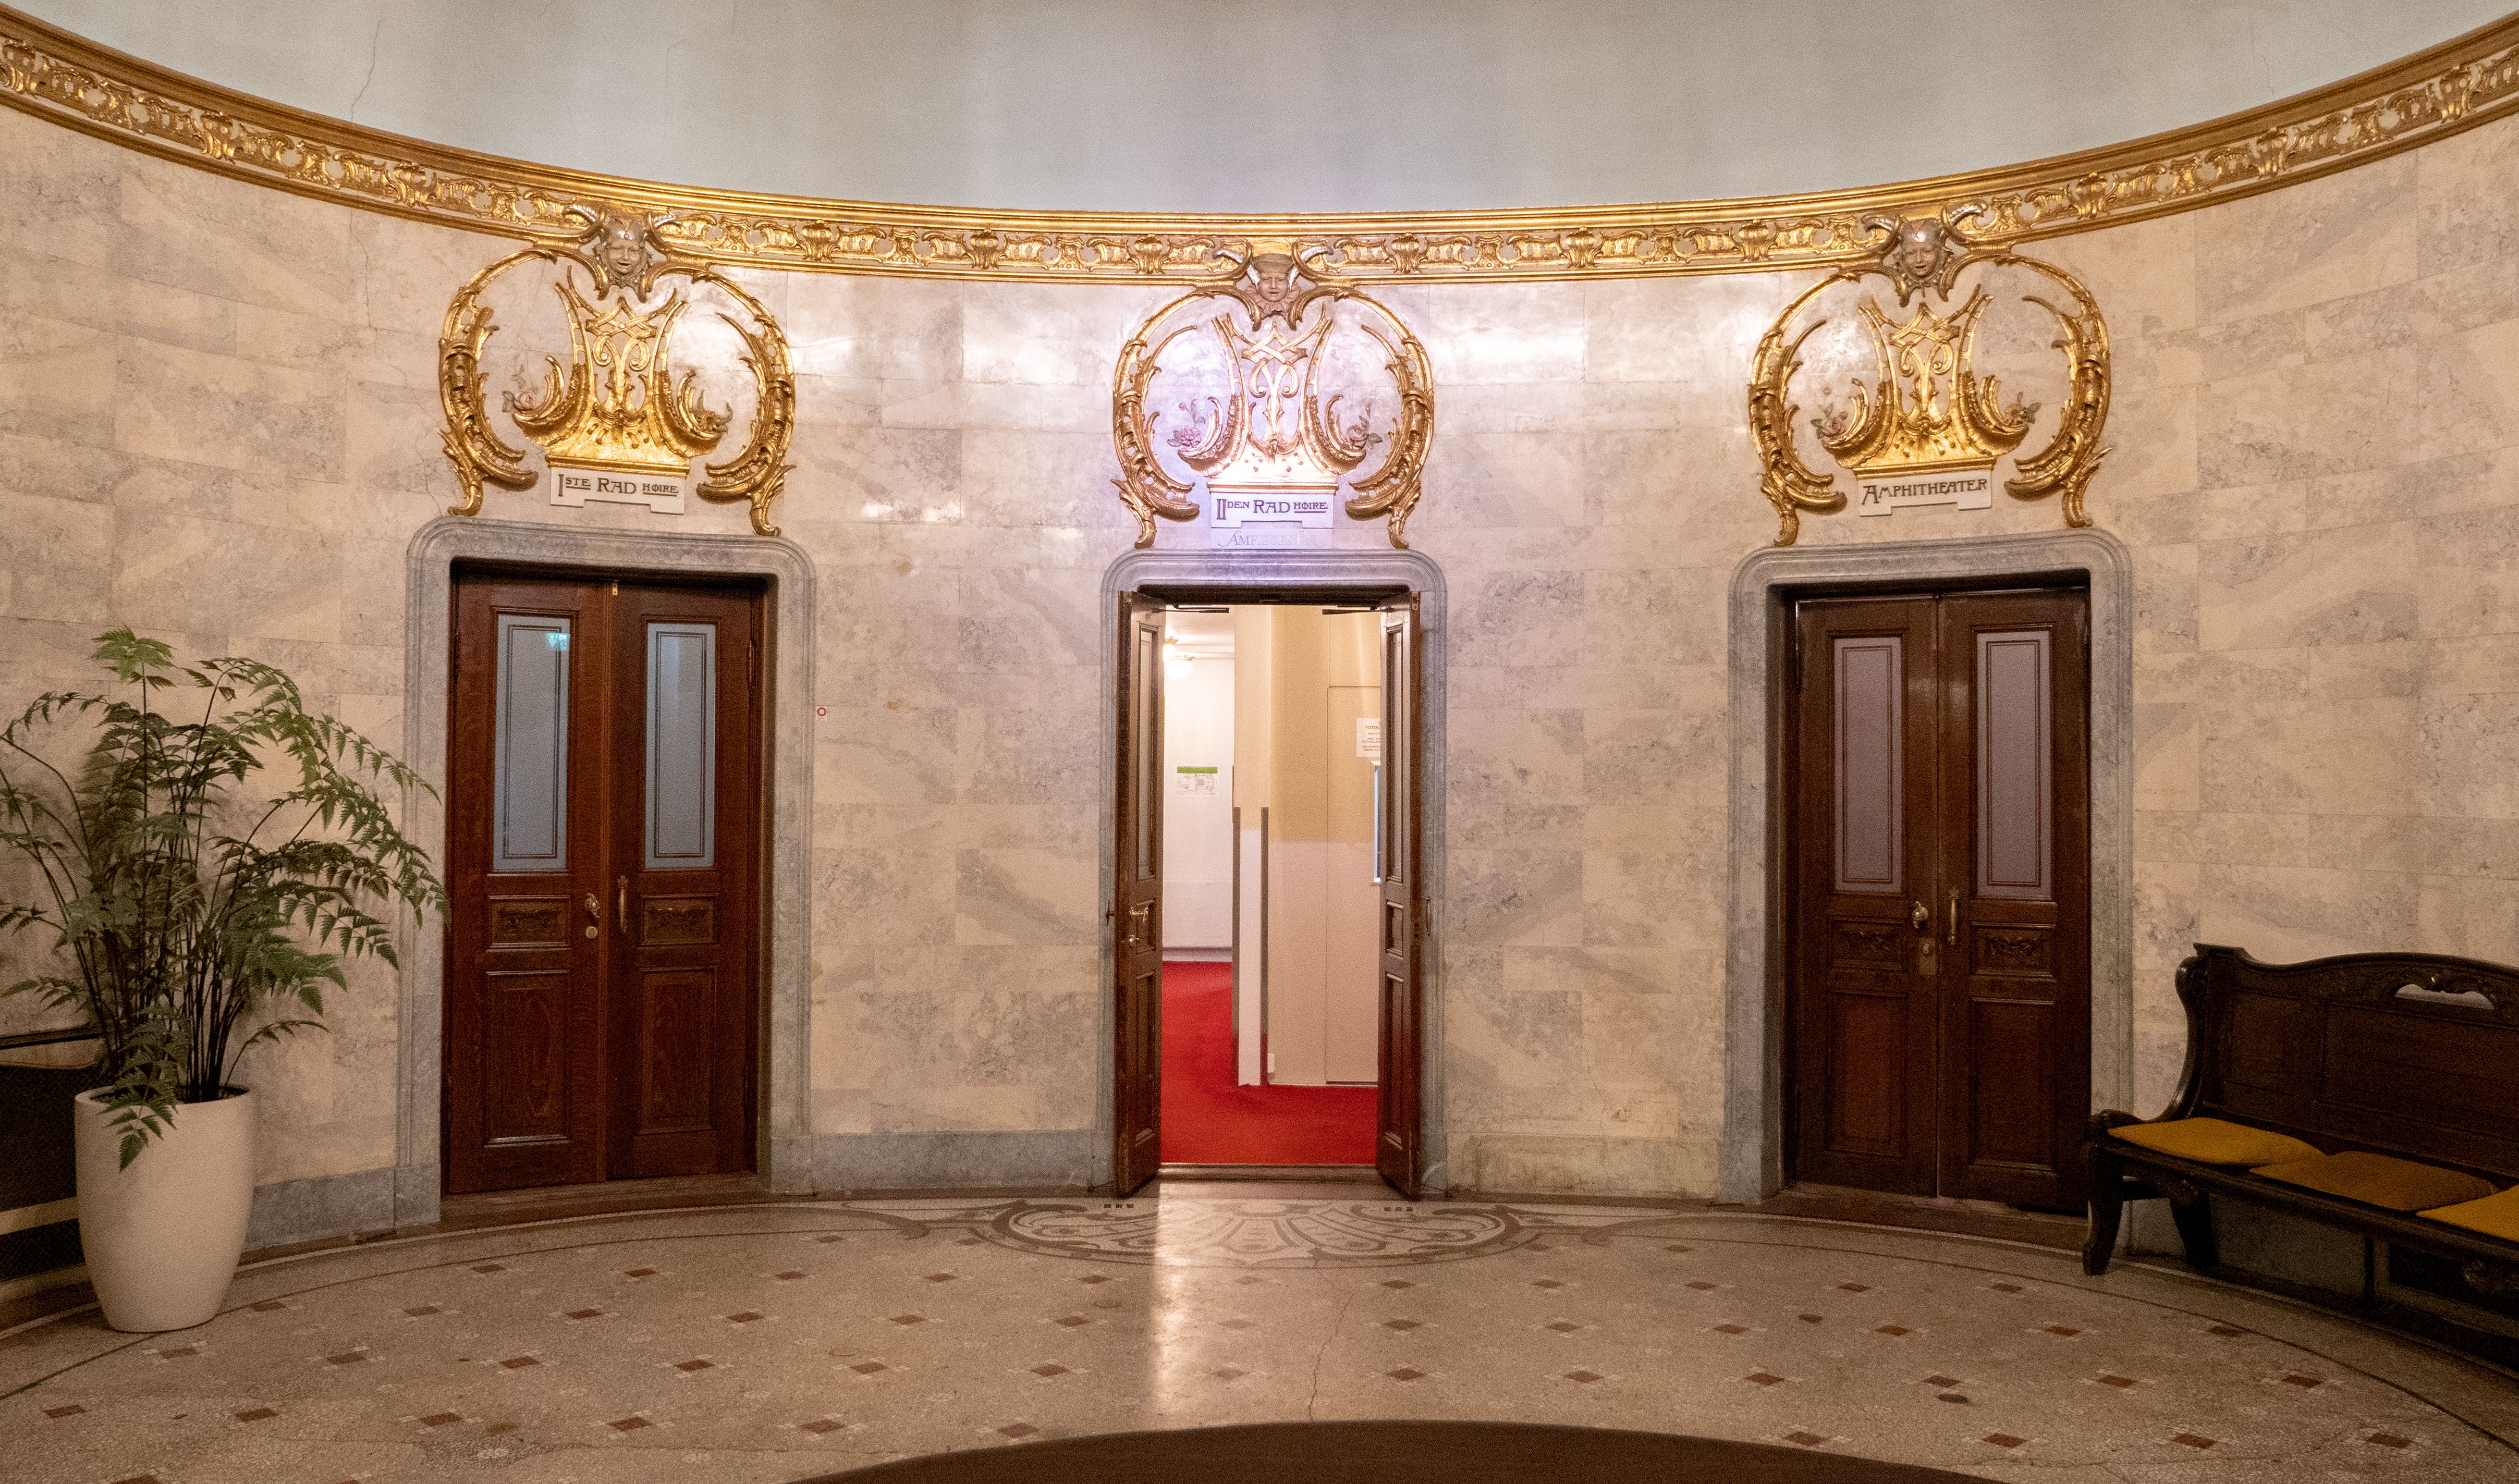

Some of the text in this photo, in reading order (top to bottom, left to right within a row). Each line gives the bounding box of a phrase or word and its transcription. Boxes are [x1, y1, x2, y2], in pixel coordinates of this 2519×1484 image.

[597, 477, 637, 494] RAD
[1861, 479, 1987, 505] AMPHITHEATER
[1253, 500, 1290, 513] RAD
[1218, 530, 1325, 547] AMFISCENEN
